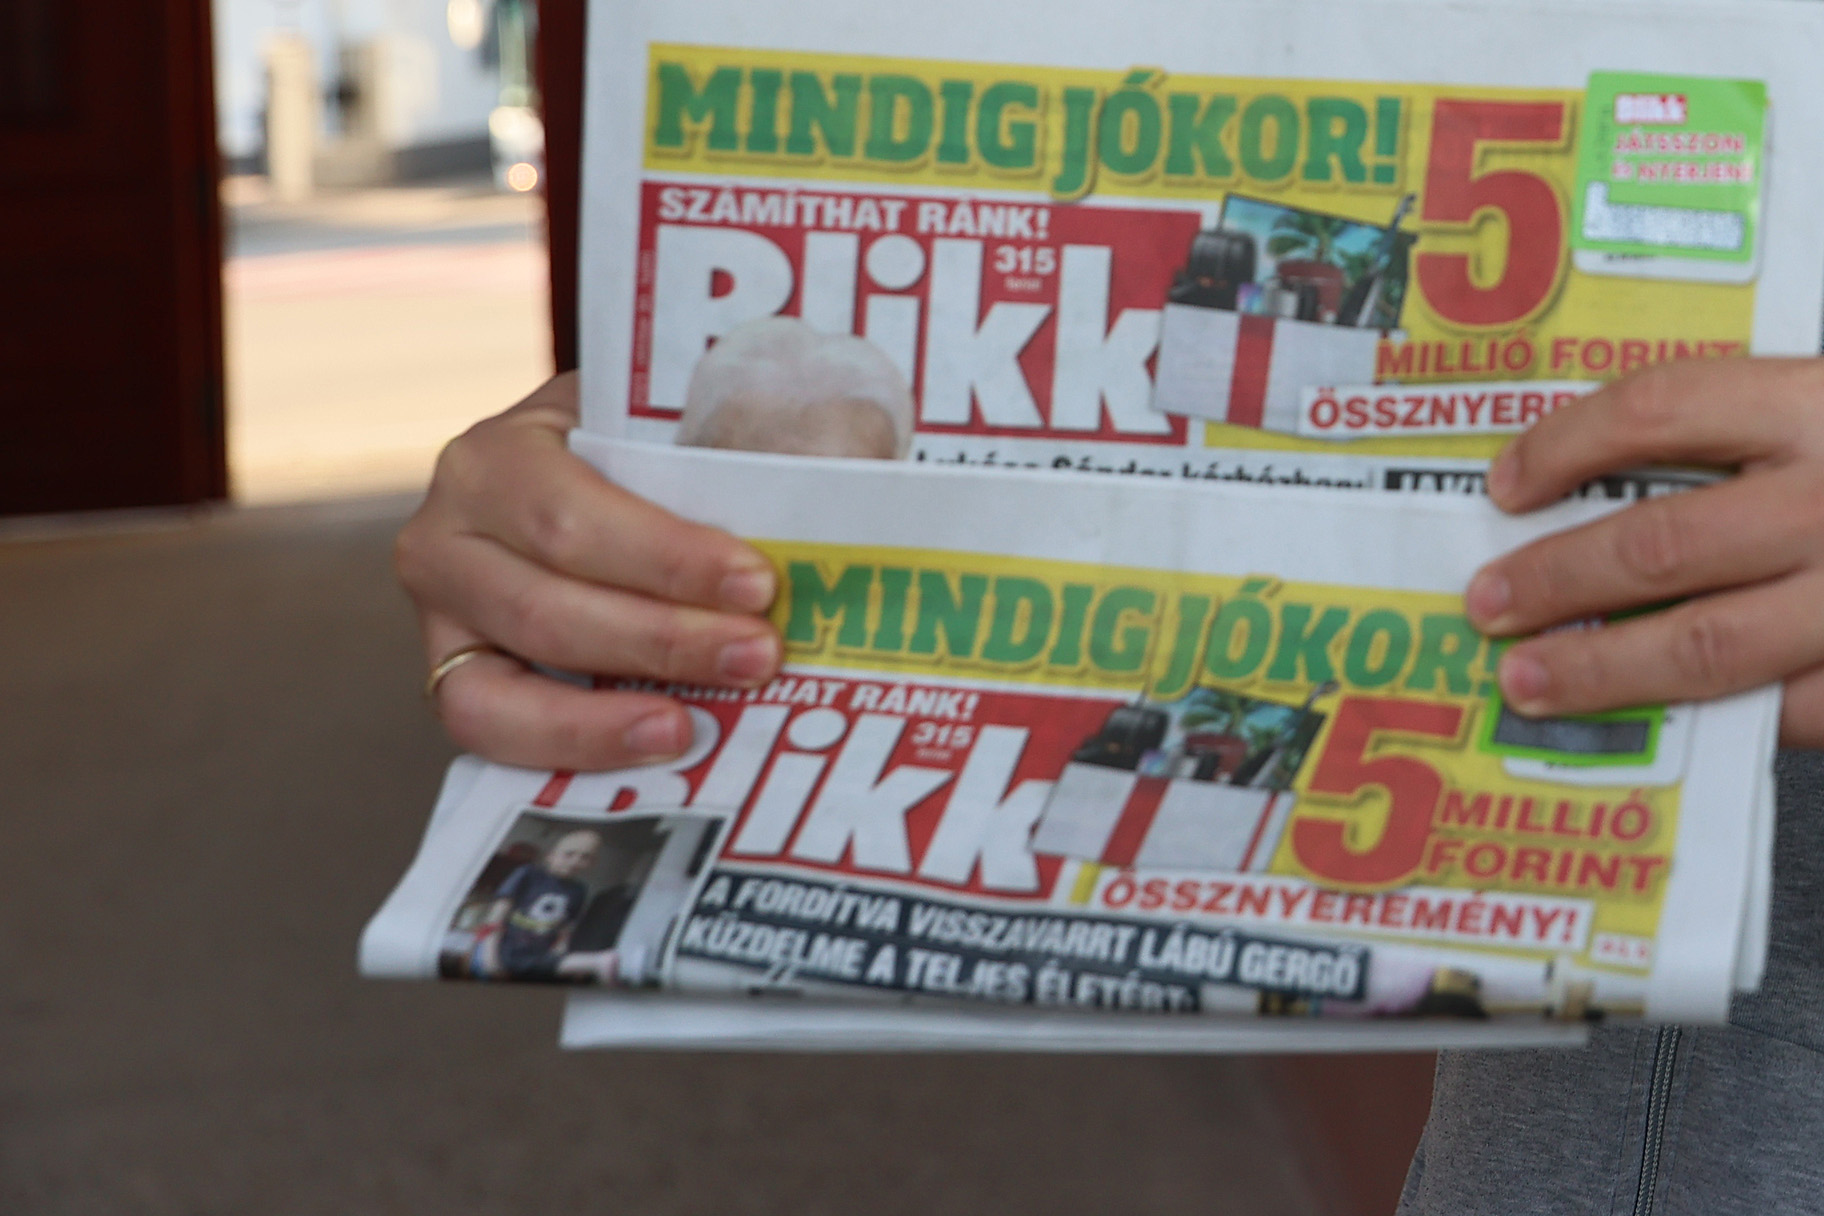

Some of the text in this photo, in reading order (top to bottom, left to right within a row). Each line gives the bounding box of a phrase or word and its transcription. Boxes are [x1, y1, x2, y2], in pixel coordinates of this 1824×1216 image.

[653, 61, 1398, 193] MINDIG JÓKOR!
[658, 185, 1051, 240] SZÁMÍTHAT RÁNK!
[1416, 98, 1563, 327] 5
[994, 244, 1057, 275] 315
[649, 225, 1173, 435] Blikk
[1376, 332, 1532, 376] MILLIÓ
[787, 561, 1158, 672] MINDIG
[850, 680, 979, 721] RÁNK!
[912, 722, 974, 748] 315
[1292, 698, 1465, 884] 5
[1441, 788, 1651, 841] MILLIÓ
[1427, 840, 1663, 891] FORINT
[701, 877, 1362, 996] A FORDÍTVA VISSZAVARRT LÁBÚ GERGŐ
[1103, 872, 1578, 942] ÖSSZNYEREMÉNY!
[684, 912, 869, 980] KÜZDELME
[864, 943, 897, 984] A
[906, 947, 1031, 1001] TELJES
